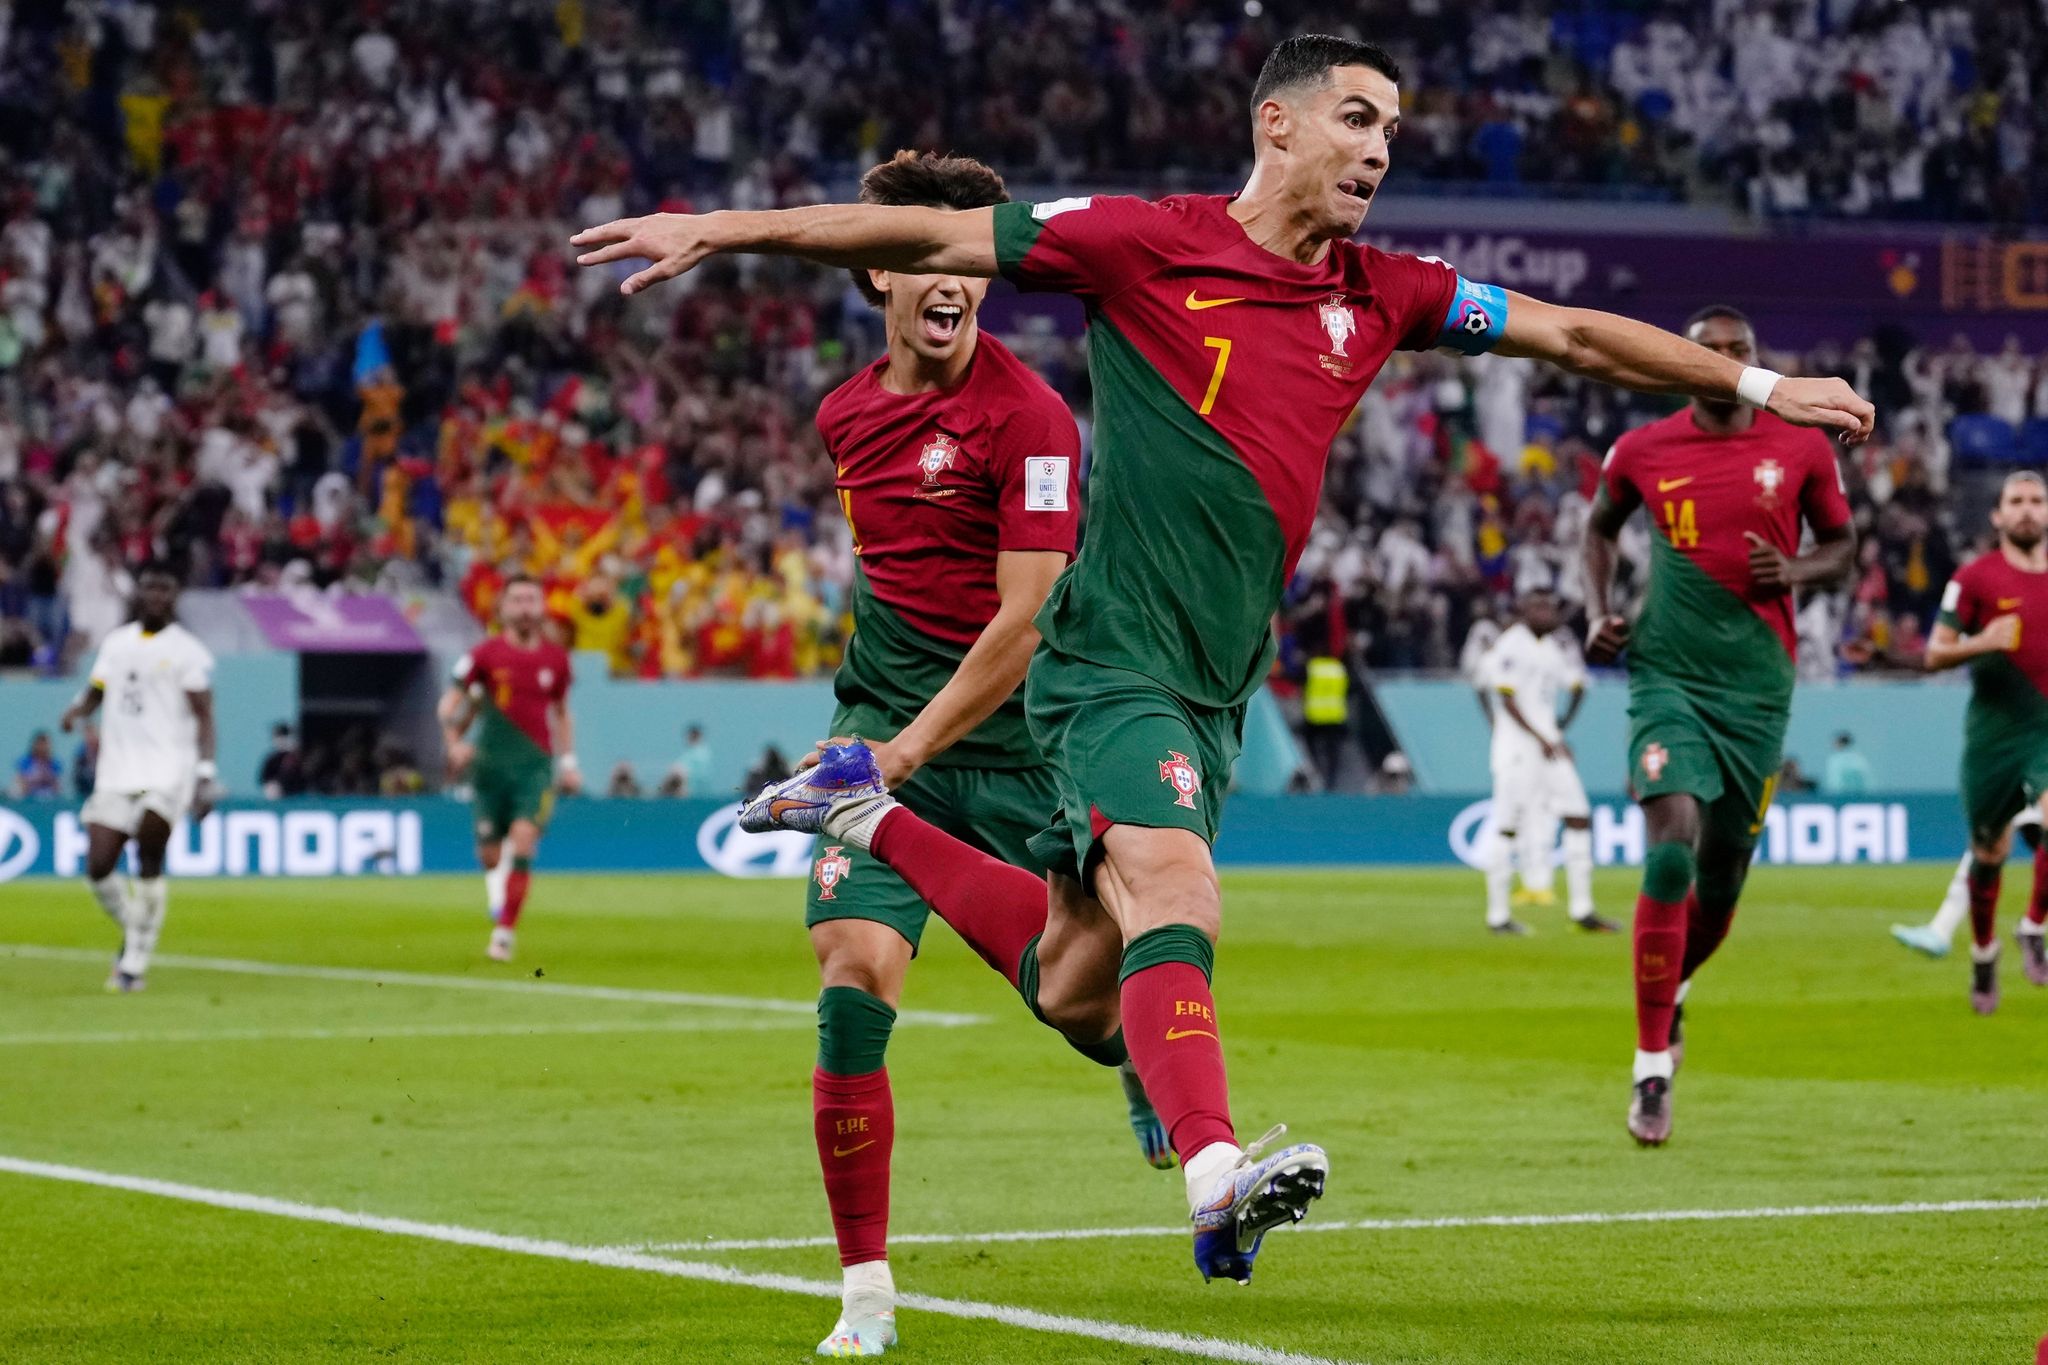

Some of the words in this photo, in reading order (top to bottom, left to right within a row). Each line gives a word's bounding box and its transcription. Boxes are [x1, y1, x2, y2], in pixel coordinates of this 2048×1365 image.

[1198, 336, 1232, 415] 7
[1664, 499, 1699, 548] 14
[53, 810, 422, 877] HUNDAI
